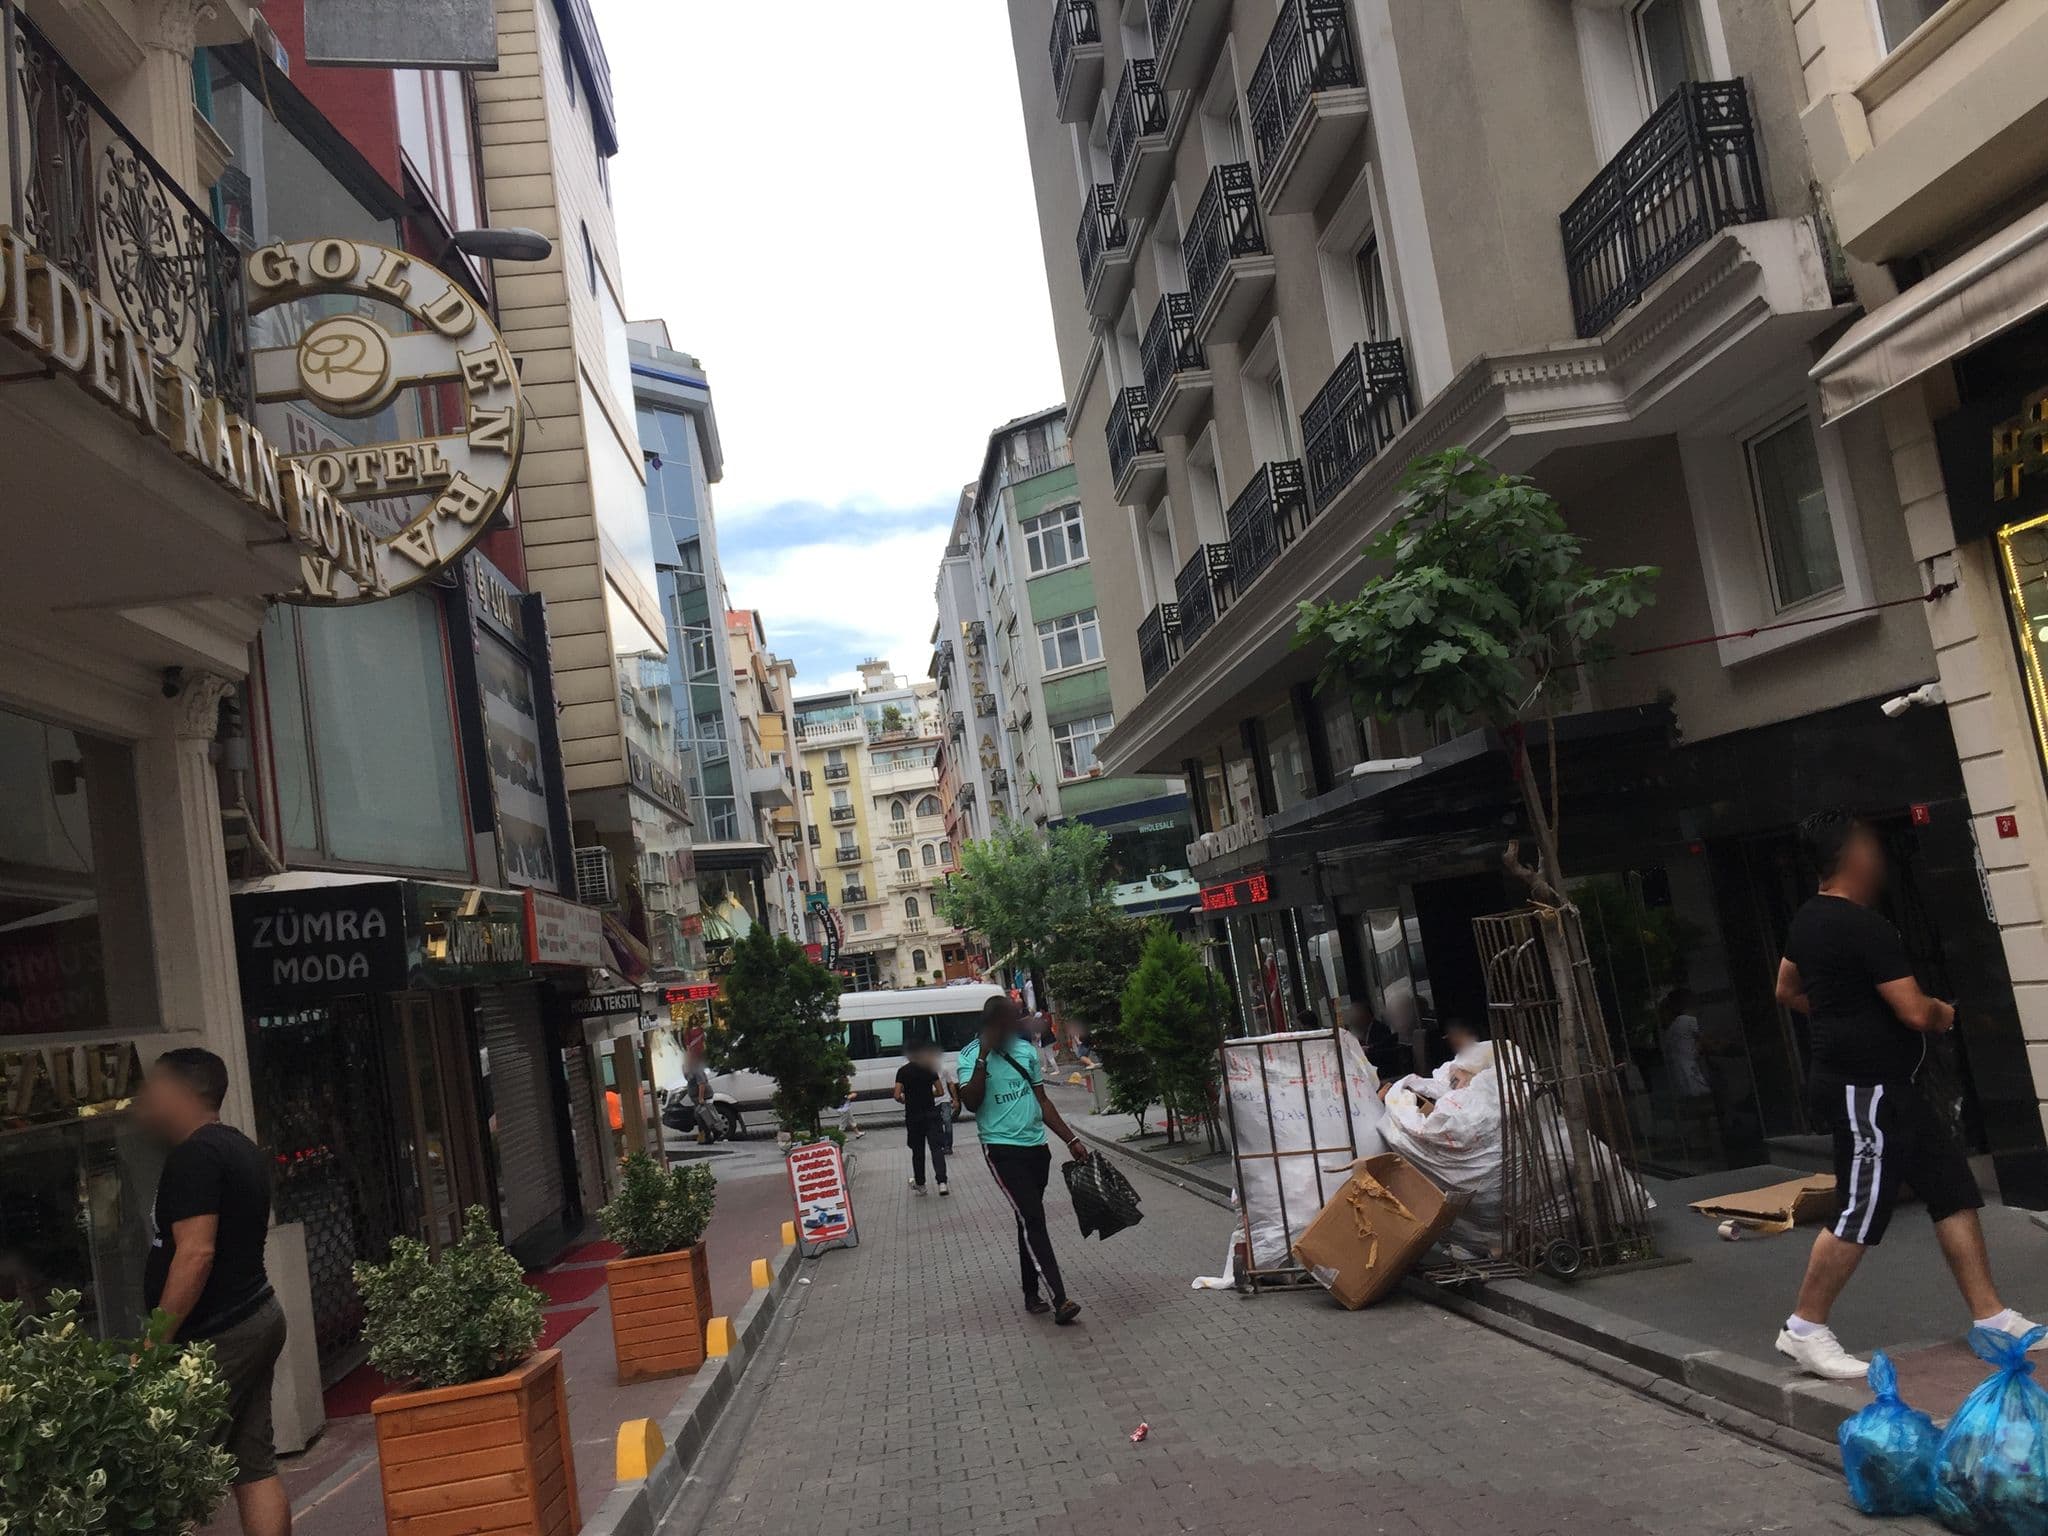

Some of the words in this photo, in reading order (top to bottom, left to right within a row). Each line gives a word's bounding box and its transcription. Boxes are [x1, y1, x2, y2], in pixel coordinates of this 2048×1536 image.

[250, 238, 512, 455] GOLDEN
[0, 226, 158, 435] LDEN
[166, 365, 288, 524] RAIN
[280, 458, 392, 598] HOTEL
[298, 443, 450, 492] OTEL
[252, 907, 387, 949] ZÜMRA
[272, 951, 371, 986] MODA
